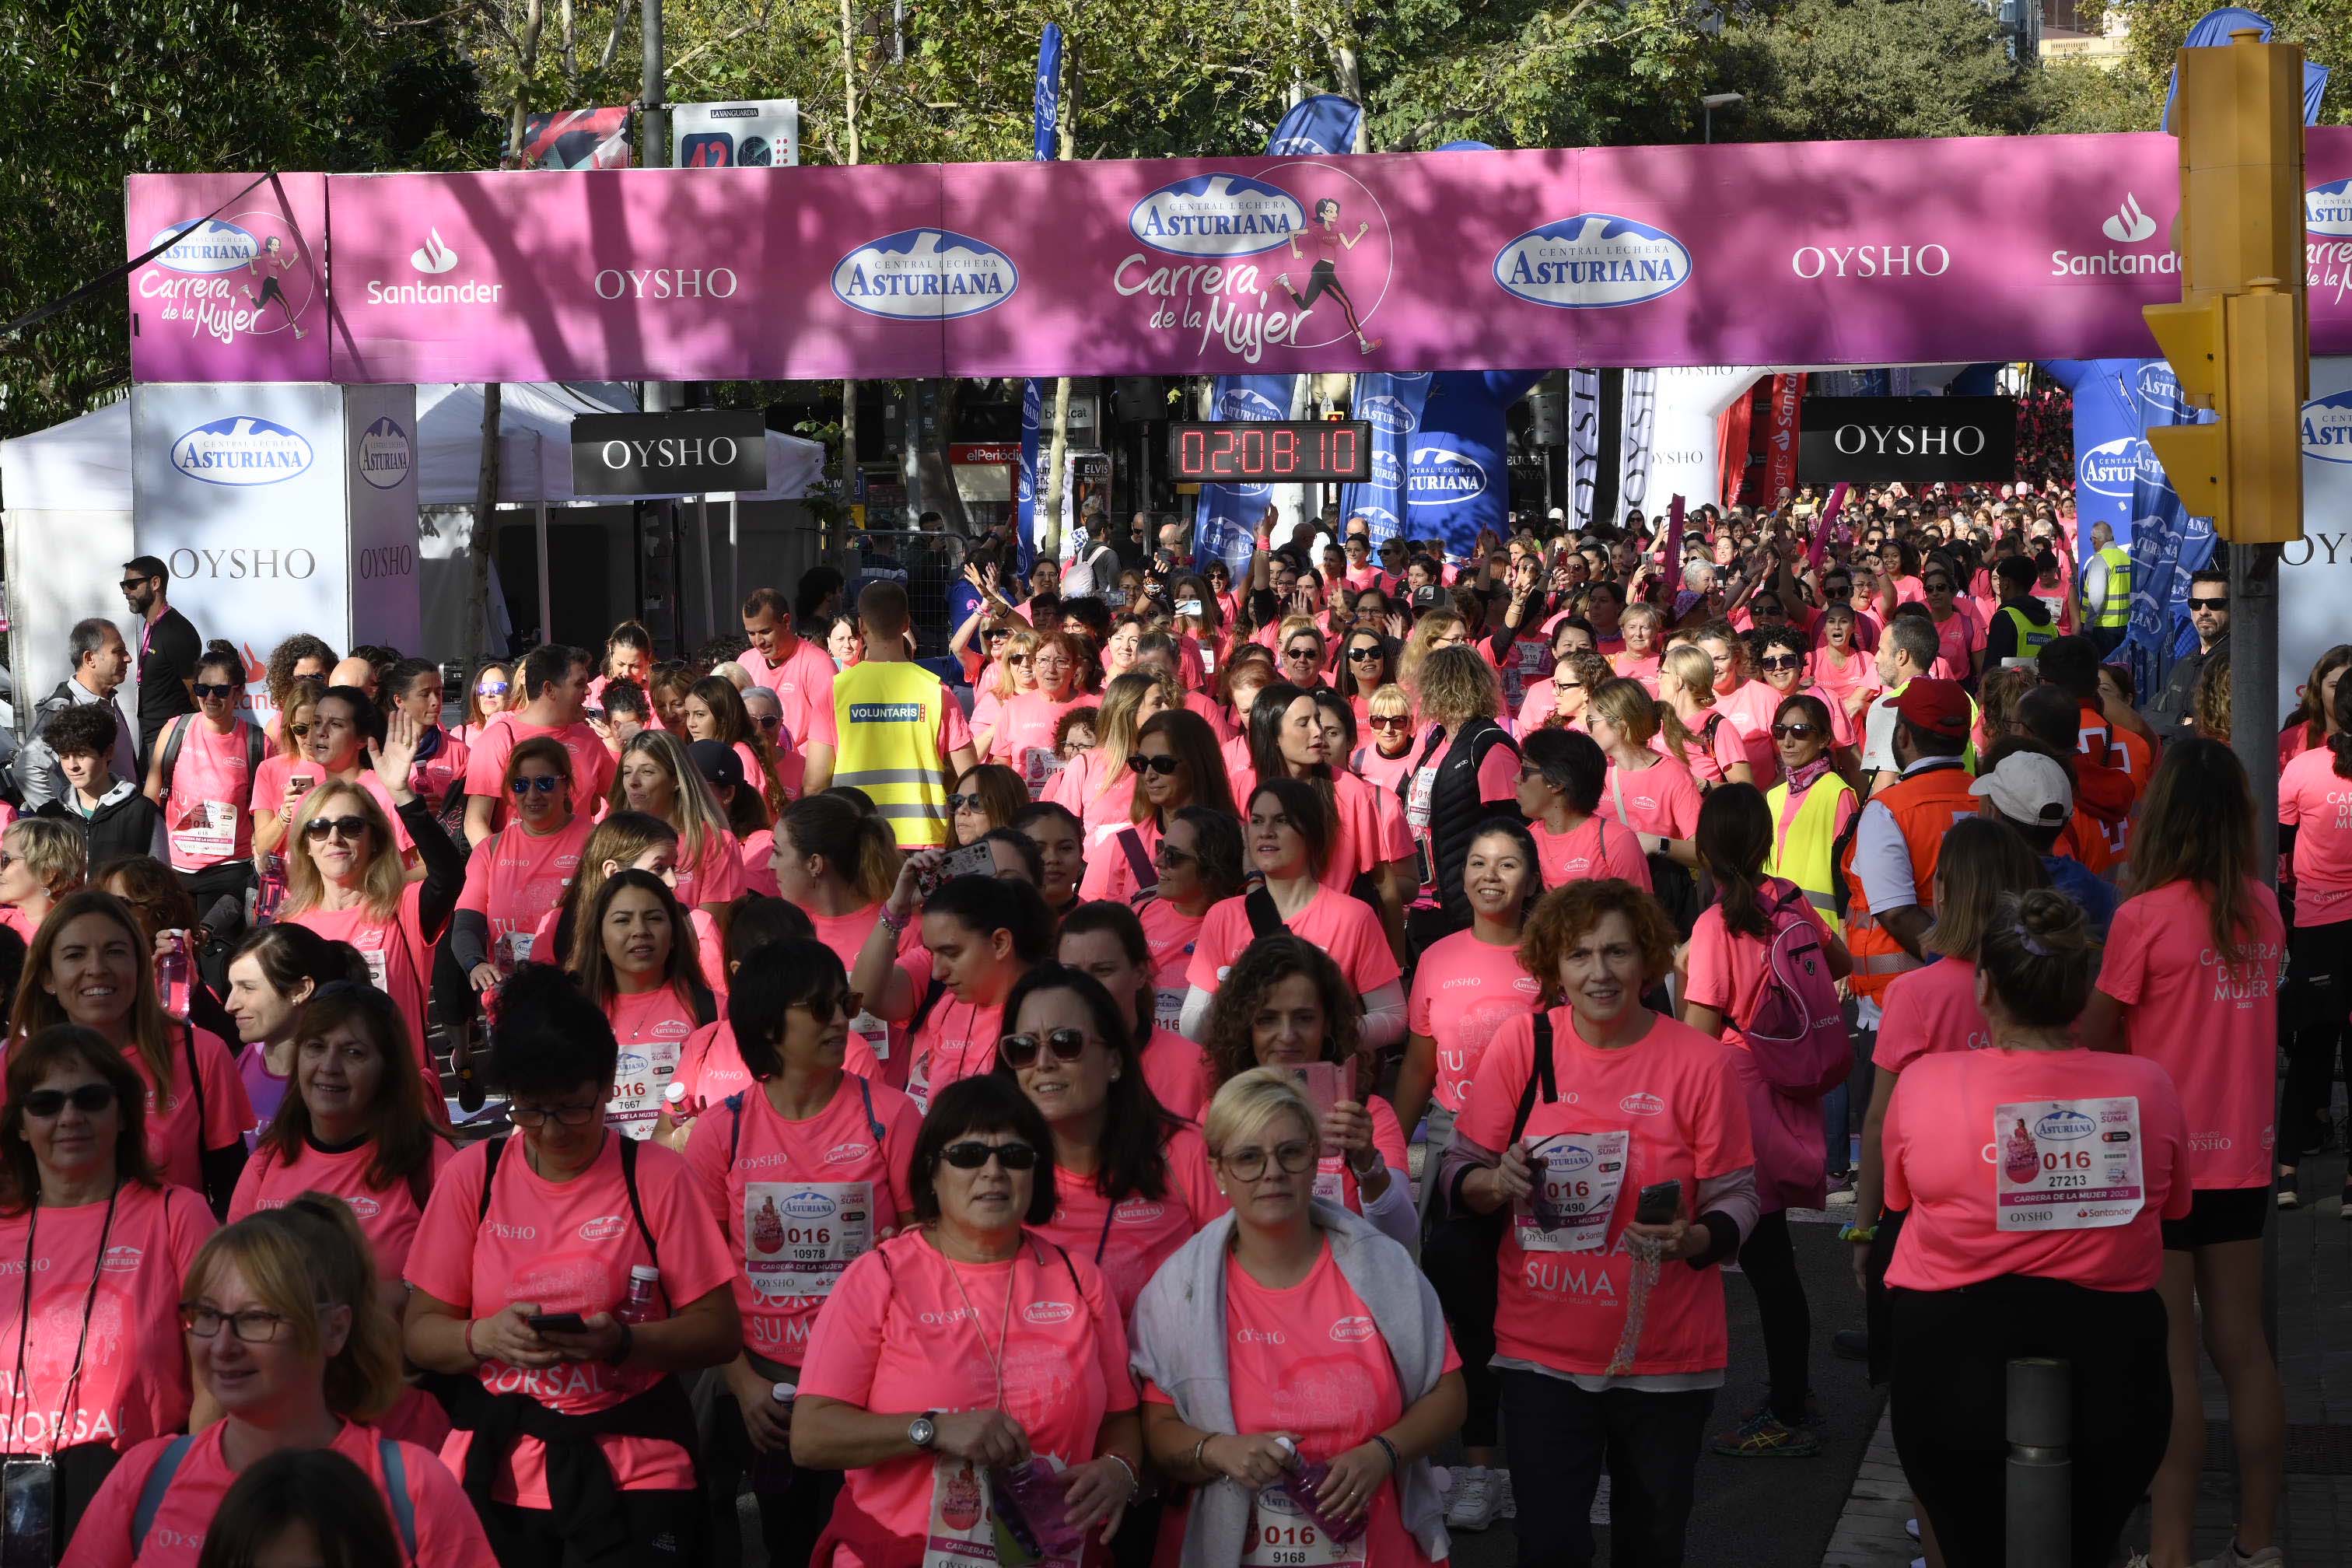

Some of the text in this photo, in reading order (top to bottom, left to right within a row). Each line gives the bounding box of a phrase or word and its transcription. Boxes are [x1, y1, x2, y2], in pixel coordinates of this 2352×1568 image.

[720, 108, 758, 117] VANGUARDIA
[1170, 201, 1286, 212] CENTRAL LECHERA
[1143, 205, 1292, 236] ASTURIANA
[1539, 245, 1669, 257] CENTRAL LECHERA
[874, 258, 998, 268] CENTRAL LECHERA
[1509, 250, 1677, 285] ASTURIANA
[1793, 243, 1950, 278] OYSHO
[2052, 249, 2182, 275] Santand
[845, 262, 1004, 296] ASTURIANA
[1114, 253, 1259, 296] Carrera
[2325, 265, 2338, 286] la
[138, 269, 230, 299] Carrera
[594, 268, 737, 300] OYSHO
[368, 280, 502, 305] Santander
[162, 296, 265, 344] de la Mujer
[1150, 290, 1314, 364] de la Mujer
[1834, 424, 1985, 457] OYSHO
[182, 442, 303, 468] ASTURIANA
[362, 443, 408, 472] ASTURIANA
[602, 436, 737, 469] OYSHO
[1085, 464, 1108, 474] ELVIS
[2279, 533, 2352, 566] OY
[169, 548, 316, 579] OYSHO
[360, 544, 411, 579] OYSHO
[852, 708, 917, 718] VOLUNTARIS
[194, 821, 214, 829] 016
[492, 919, 516, 934] TU
[1443, 977, 1481, 989] OYSHO
[2214, 981, 2269, 1002] MUJER
[1440, 1050, 1464, 1071] TU
[612, 1082, 646, 1098] 016
[618, 1101, 640, 1109] 7667
[1624, 1100, 1662, 1112] ASTURIANA
[2039, 1122, 2091, 1135] ASTURIANA
[1598, 1147, 1621, 1156] SUMA
[2188, 1138, 2231, 1151] YSHO
[740, 1152, 787, 1170] OYSHO
[1548, 1157, 1589, 1166] STURIANA
[2043, 1151, 2091, 1171] 016
[2049, 1174, 2086, 1188] 27213
[1548, 1181, 1589, 1199] 016
[786, 1199, 831, 1213] ASTURIANA
[2014, 1195, 2052, 1203] CARRERA
[1115, 1206, 1161, 1218] ASTURIANA
[2011, 1211, 2053, 1223] OYSHO
[2089, 1208, 2133, 1218] Santander
[788, 1228, 831, 1244] 016
[1524, 1233, 1557, 1243] OYSHO
[793, 1249, 825, 1258] 10978
[758, 1279, 794, 1288] OYSHO
[1526, 1262, 1615, 1296] SUMA
[921, 1307, 979, 1325] OYSHO
[1028, 1309, 1071, 1321] ASTURIANA
[159, 1530, 204, 1549] OYS
[1265, 1525, 1315, 1545] 016
[946, 1541, 986, 1556] CARRERA
[1274, 1551, 1306, 1563] 9168
